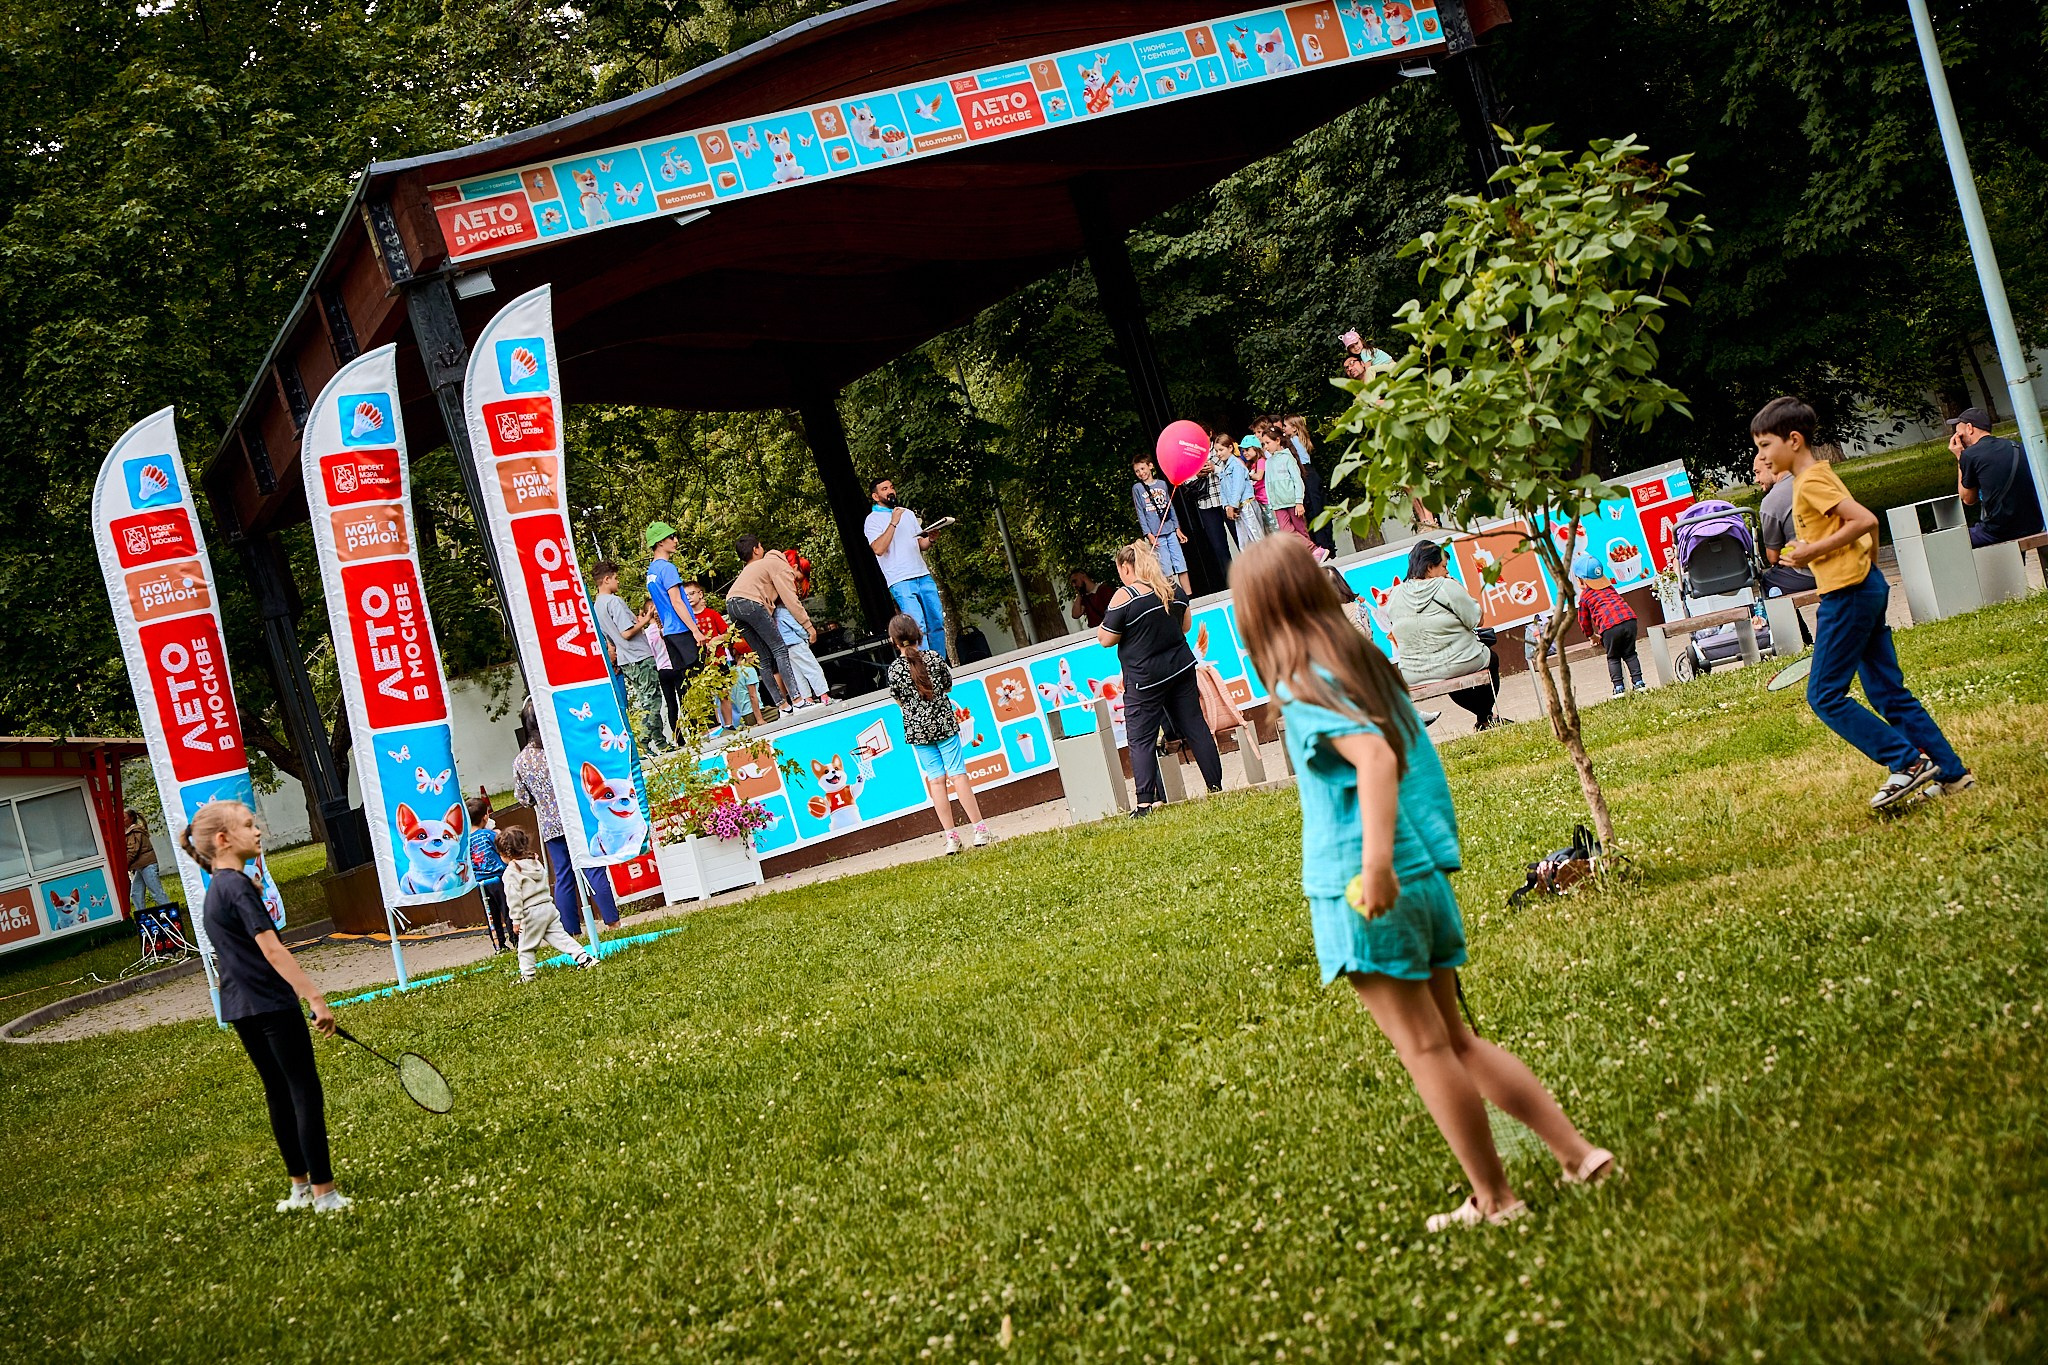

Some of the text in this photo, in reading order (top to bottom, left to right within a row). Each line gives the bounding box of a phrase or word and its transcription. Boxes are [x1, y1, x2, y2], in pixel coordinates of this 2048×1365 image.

[1143, 42, 1167, 53] ИЮНЯ
[1147, 46, 1186, 60] СЕНТЯБРЯ
[971, 91, 1028, 119] ЛЕТО
[973, 109, 1033, 131] В МОСКВЕ
[918, 132, 963, 149] leto.mos.ru
[664, 190, 707, 205] leto.mos.ru
[453, 202, 518, 233] ЛЕТО
[455, 222, 524, 246] В МОСКВЕ
[357, 463, 385, 472] ПРОЕКТ
[359, 471, 379, 479] МЭРА
[360, 477, 391, 486] МОСКВЫ
[148, 522, 176, 533] ПРОЕКТ
[149, 530, 171, 540] МЭРА
[344, 514, 378, 538] мой
[151, 535, 183, 546] МОСКВЫ
[138, 574, 173, 598] мой
[534, 538, 588, 657] ЛЕТО
[360, 585, 409, 702] ЛЕТО
[392, 581, 430, 701] В МОСКВЕ
[160, 641, 214, 752] ЛЕТО
[191, 636, 236, 751] В МОСКВЕ
[834, 792, 846, 806] 1
[627, 862, 644, 880] В
